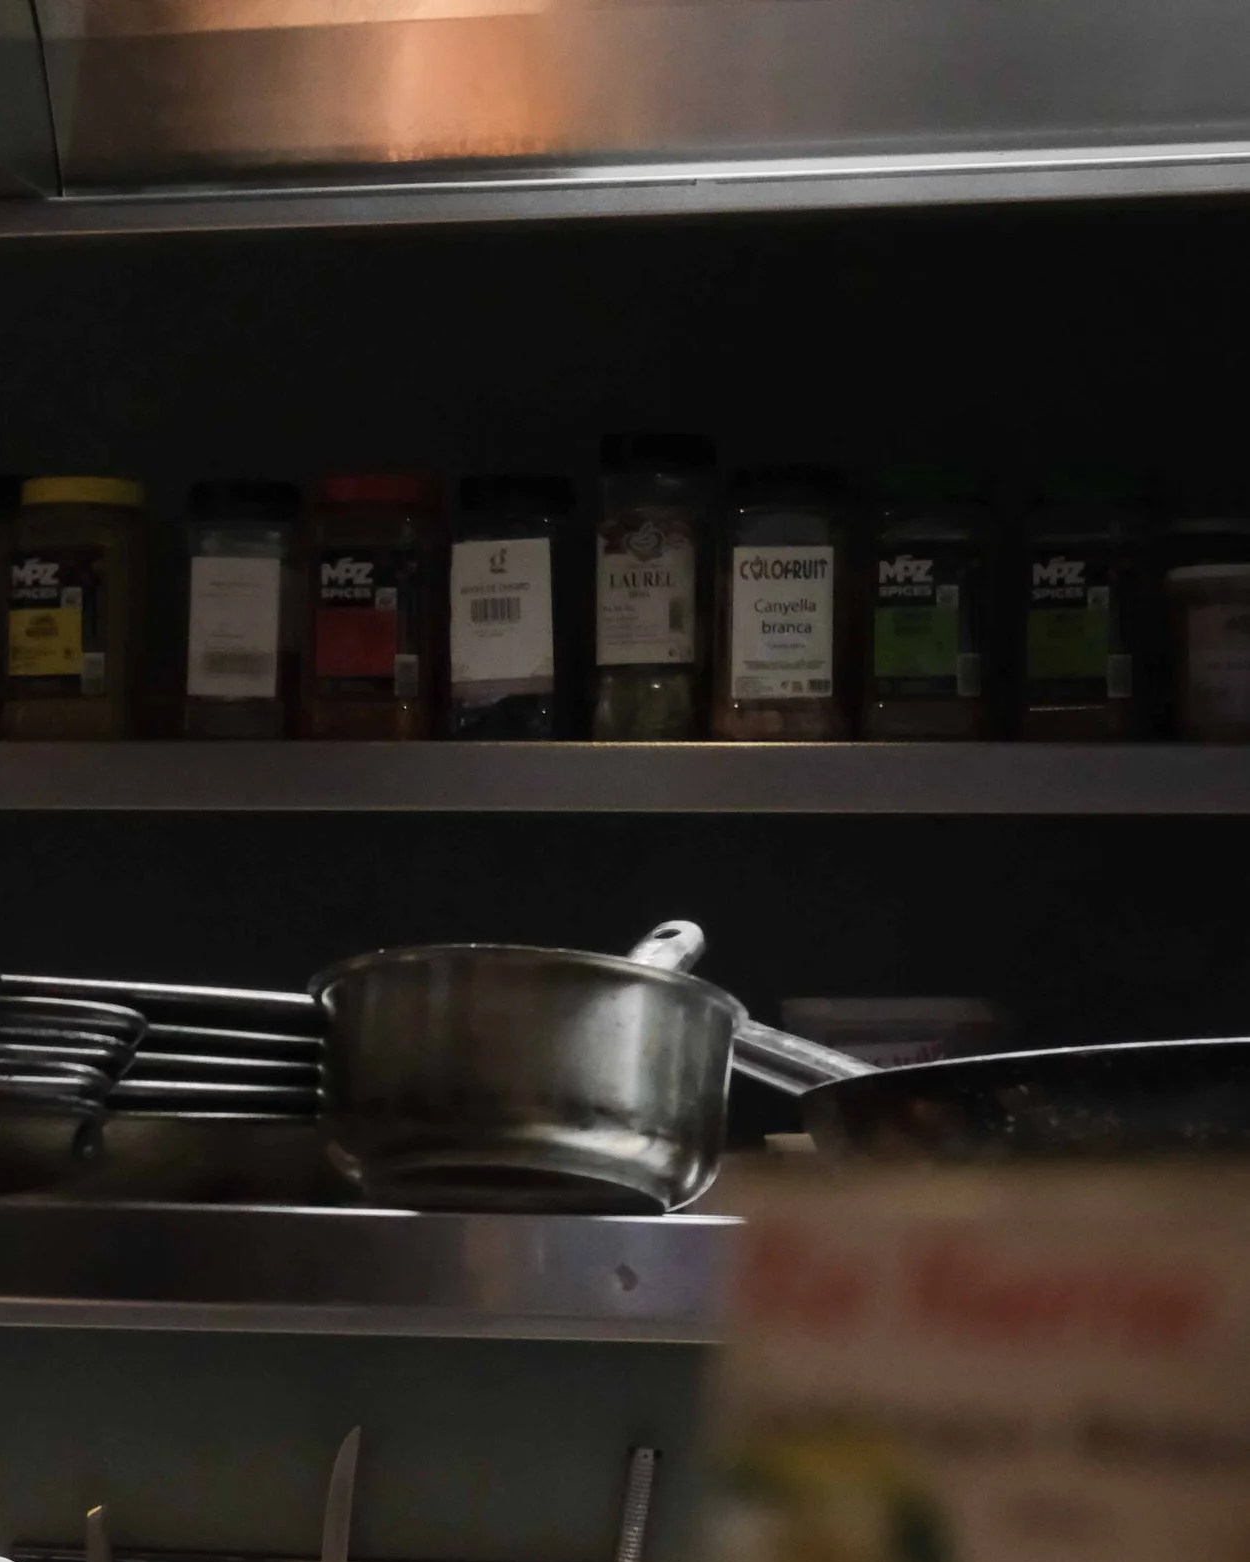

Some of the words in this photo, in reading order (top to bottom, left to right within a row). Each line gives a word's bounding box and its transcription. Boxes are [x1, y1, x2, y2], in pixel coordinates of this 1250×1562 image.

[610, 571, 676, 588] LAUREL
[320, 587, 373, 600] SPICES
[878, 584, 933, 597] SPICES
[754, 599, 817, 615] Canyella
[761, 620, 812, 635] branca
